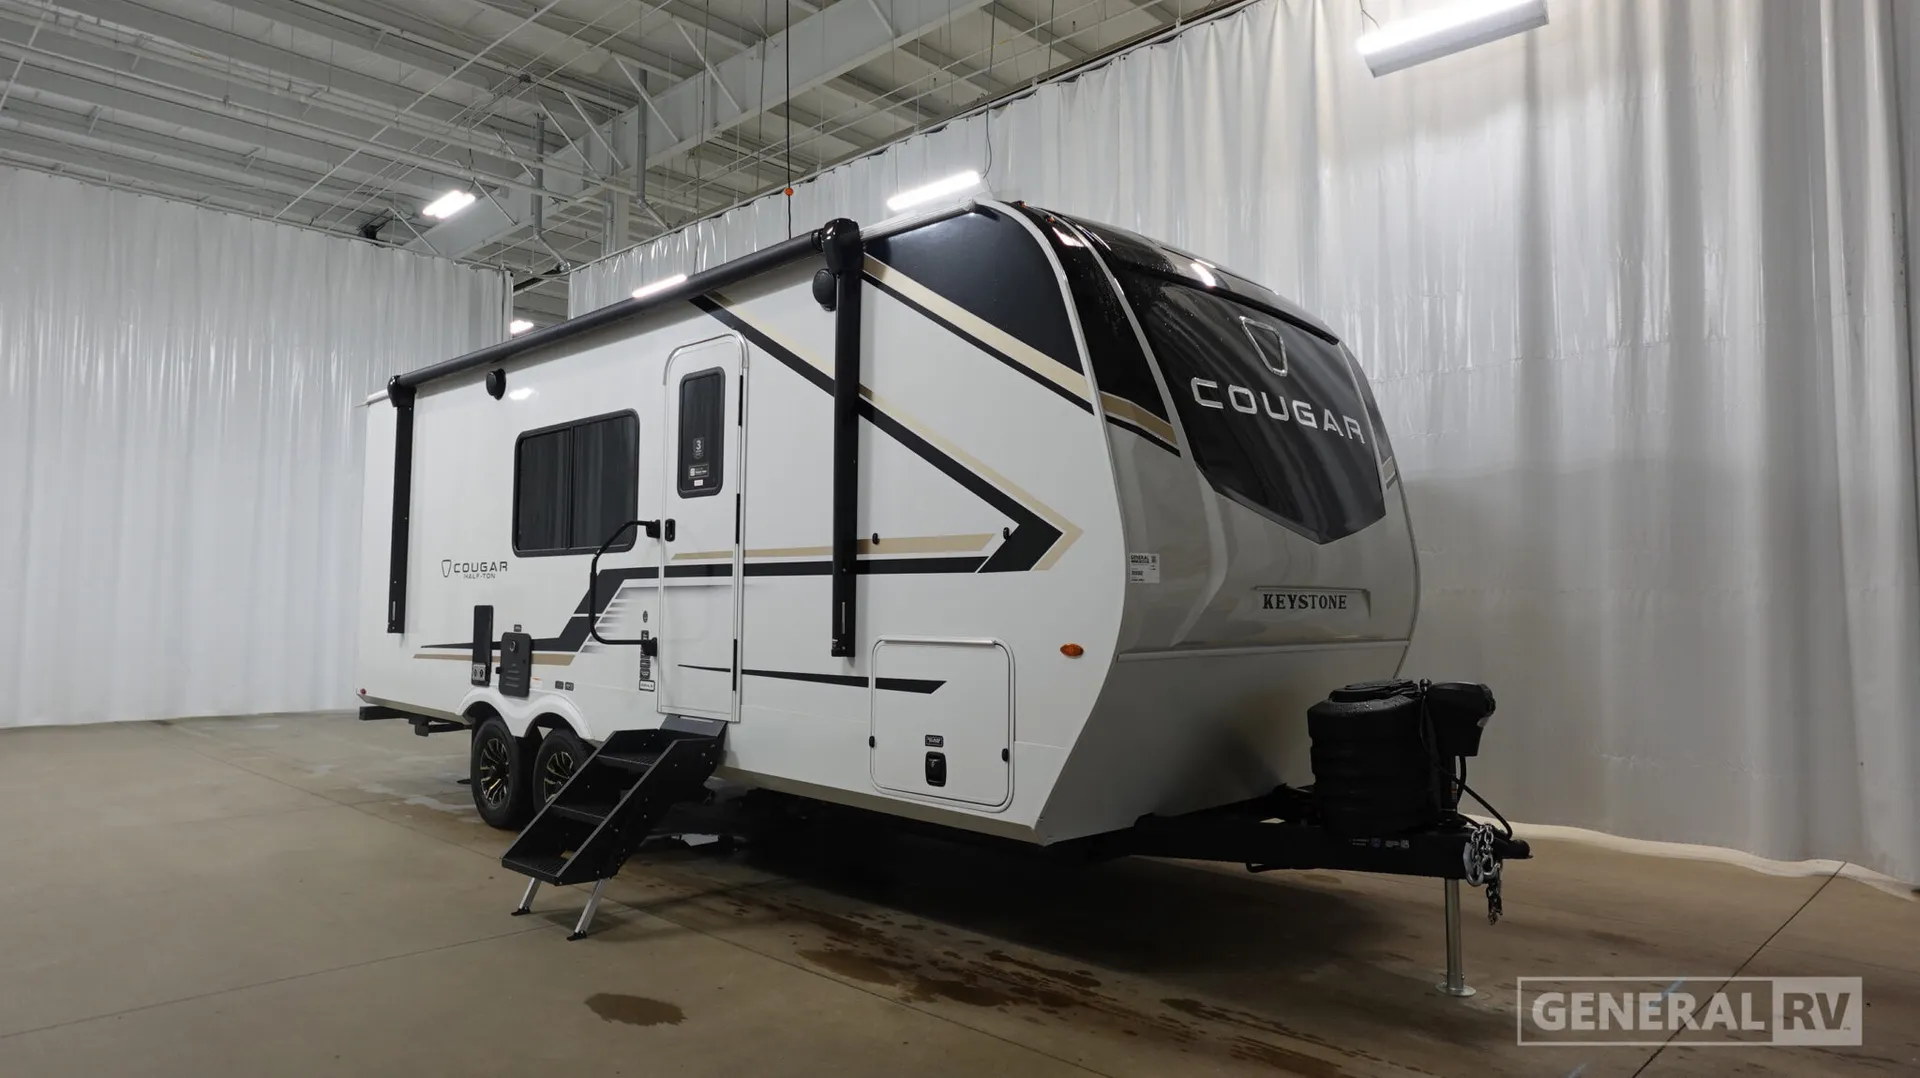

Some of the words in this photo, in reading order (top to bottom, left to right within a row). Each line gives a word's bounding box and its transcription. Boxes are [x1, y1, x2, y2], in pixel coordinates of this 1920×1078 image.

[1190, 376, 1366, 445] COUGAR
[453, 561, 508, 573] COUGAR
[1262, 594, 1347, 610] KEYSTONE
